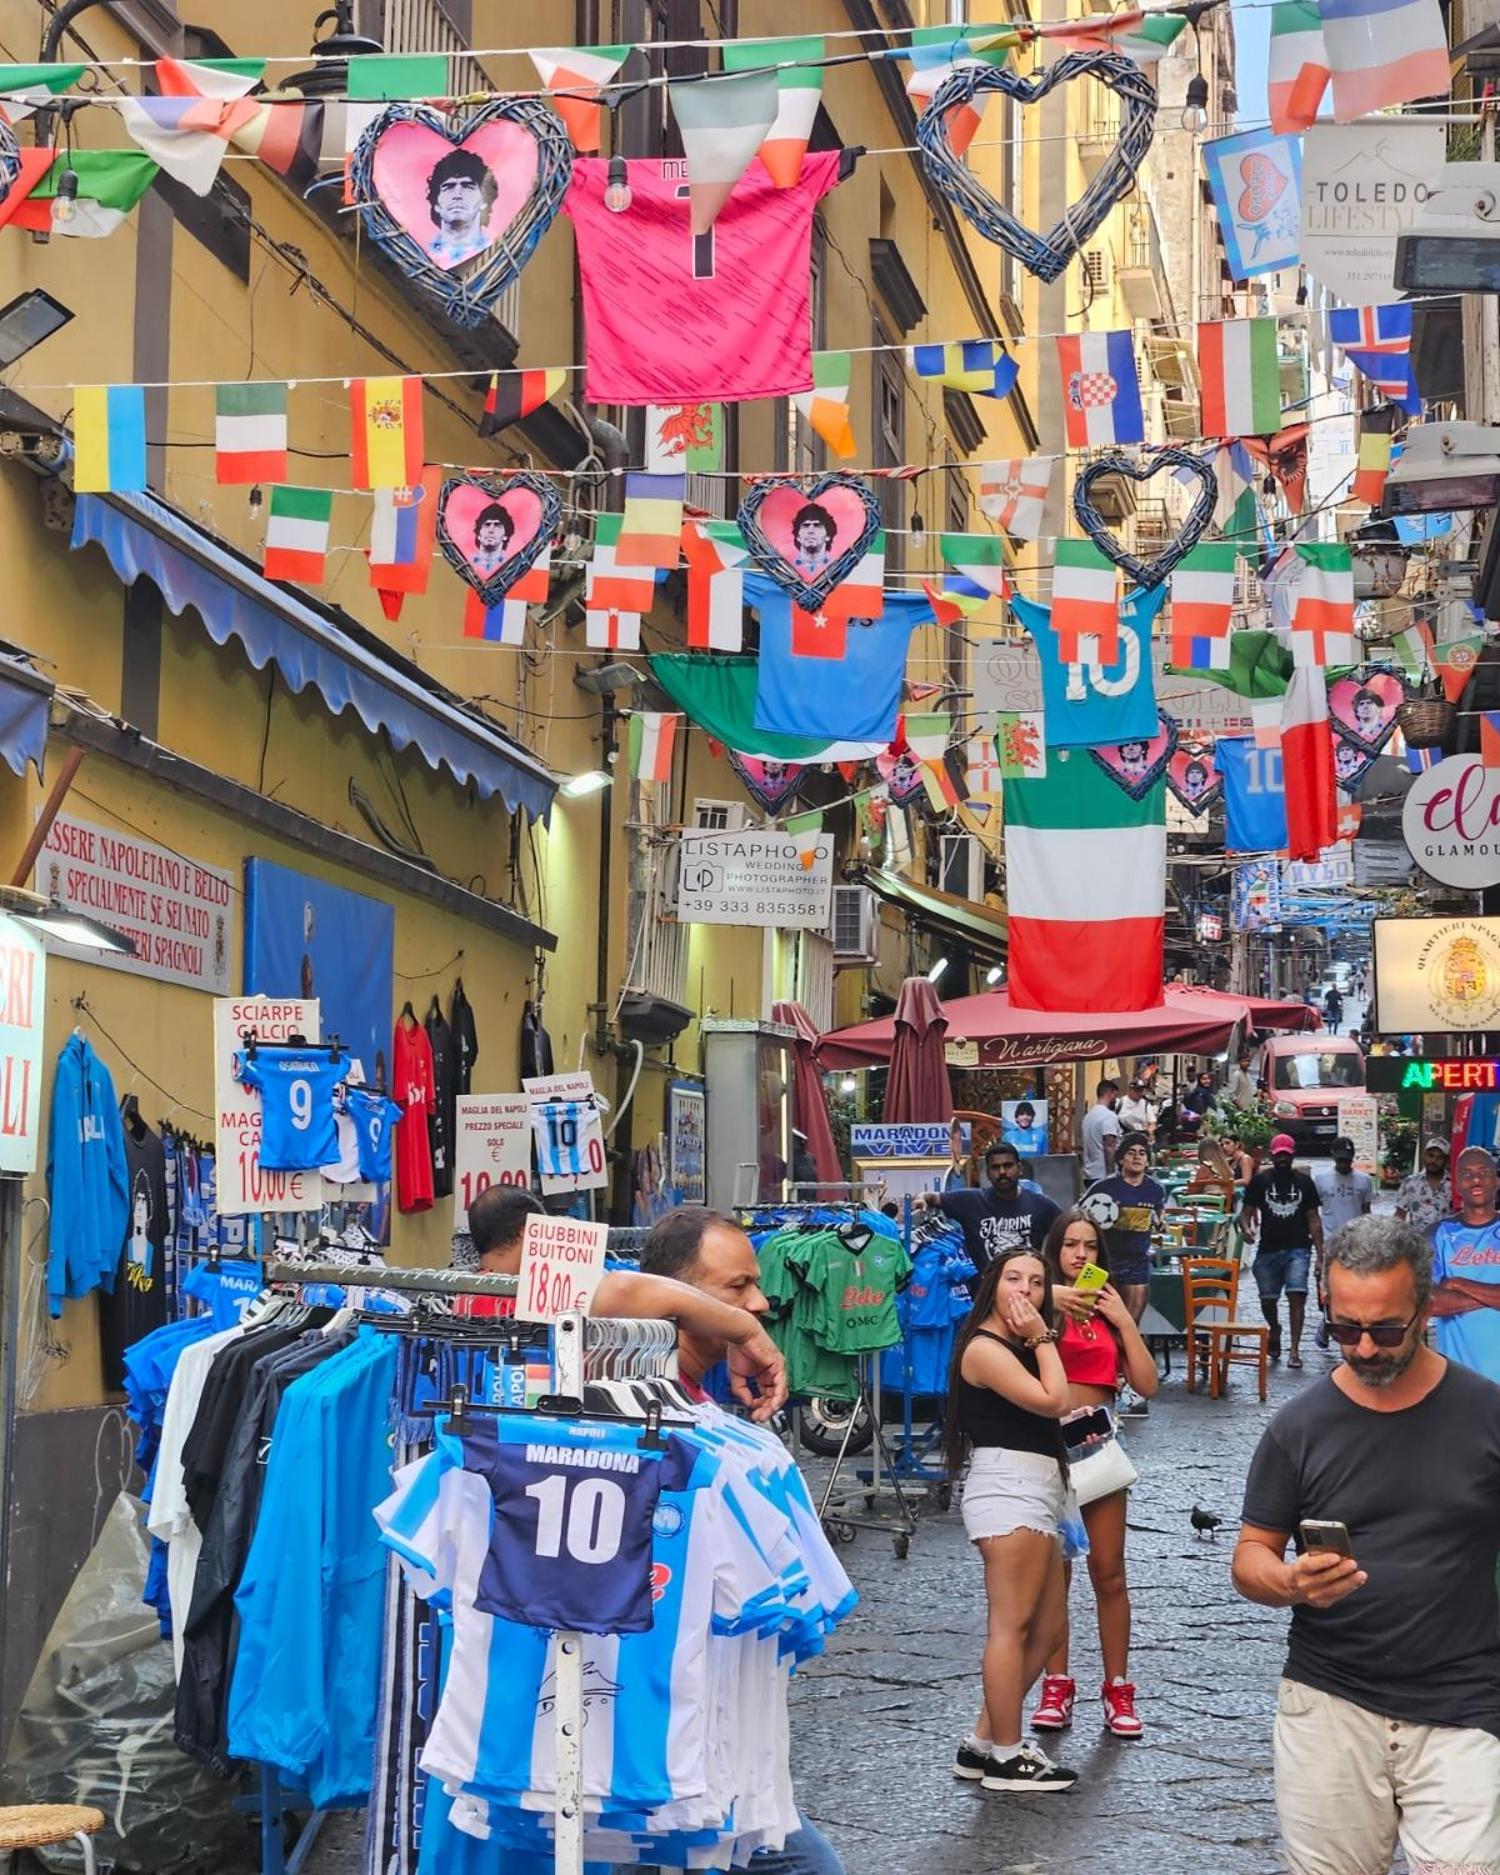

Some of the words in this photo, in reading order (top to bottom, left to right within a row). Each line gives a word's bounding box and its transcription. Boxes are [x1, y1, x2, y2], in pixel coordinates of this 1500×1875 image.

[1316, 182, 1429, 203] TOLEDO
[685, 840, 829, 860] LISTAPHOO
[100, 836, 181, 892] NAPOLETANO
[184, 866, 191, 895] E
[194, 868, 230, 907] BELLO
[745, 861, 805, 872] WEDDING
[726, 873, 828, 884] PHOTOGRAPHER
[67, 869, 147, 922] SPECIALMENTE
[150, 895, 163, 926] SE
[166, 899, 182, 932] SEI
[184, 904, 210, 939] NATO
[683, 900, 713, 911] +39
[720, 901, 749, 914] 333
[756, 902, 826, 916] 8353581
[154, 936, 203, 977] SPAGNOLI
[232, 1005, 304, 1021] SCIARPE
[1401, 1062, 1499, 1089] APERT
[289, 1079, 313, 1131] 9
[461, 1106, 489, 1114] MAGLIA
[490, 1105, 503, 1114] DEL
[505, 1104, 527, 1113] NAPOLI
[464, 1122, 492, 1131] PREZZO
[493, 1121, 524, 1130] SPECIALE
[547, 1119, 577, 1147] 10
[855, 1127, 967, 1140] MARADONA
[487, 1138, 505, 1147] SOLO
[290, 1173, 304, 1200] €
[528, 1223, 598, 1247] GIUBBINI
[528, 1242, 593, 1265] BUITONI
[528, 1261, 571, 1319] 18,00
[574, 1291, 587, 1310] €
[525, 1444, 640, 1474] MARADONA
[524, 1474, 626, 1565] 10
